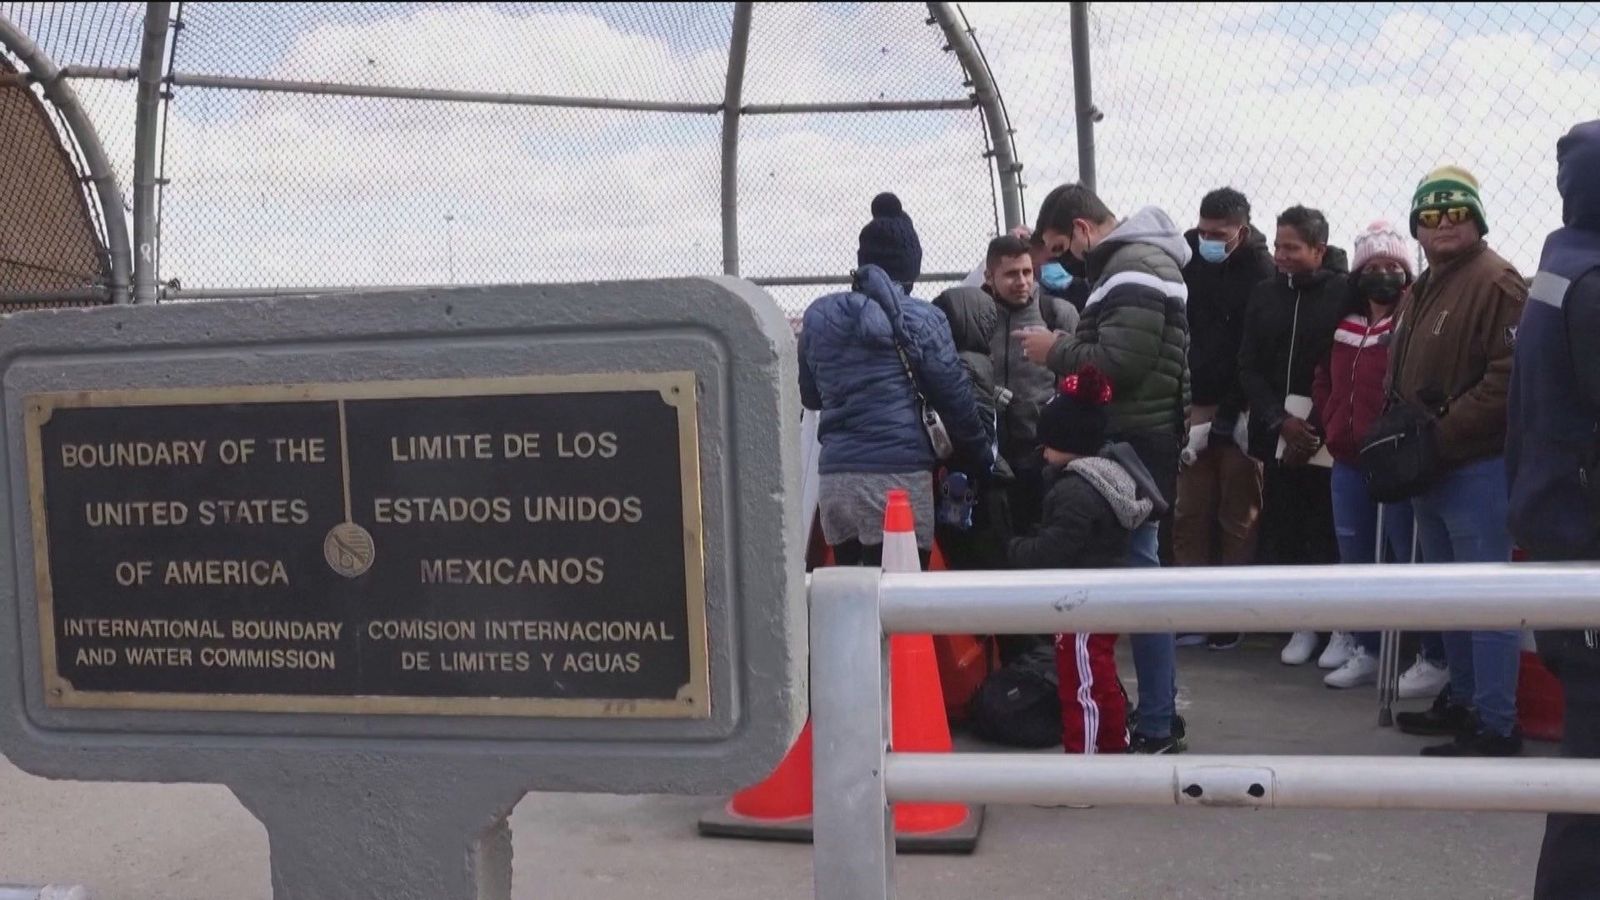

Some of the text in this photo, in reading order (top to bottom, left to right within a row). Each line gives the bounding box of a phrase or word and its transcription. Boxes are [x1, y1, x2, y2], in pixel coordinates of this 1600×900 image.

[61, 436, 326, 468] BOUNDARY OF THE
[391, 431, 618, 462] LIMITE DE LOS
[85, 498, 309, 527] UNITED STATES
[374, 495, 643, 524] ESTADOS UNIDOS
[115, 560, 289, 586] OF AMERICA
[421, 556, 604, 585] MEXICANOS
[63, 619, 343, 641] INTERNATIONAL BOUNDARY
[367, 619, 675, 642] COMISION INTERNACIONAL
[75, 647, 336, 670] AND WATER COMMISSION
[401, 651, 641, 673] DE LIMITES Y AGUAS
